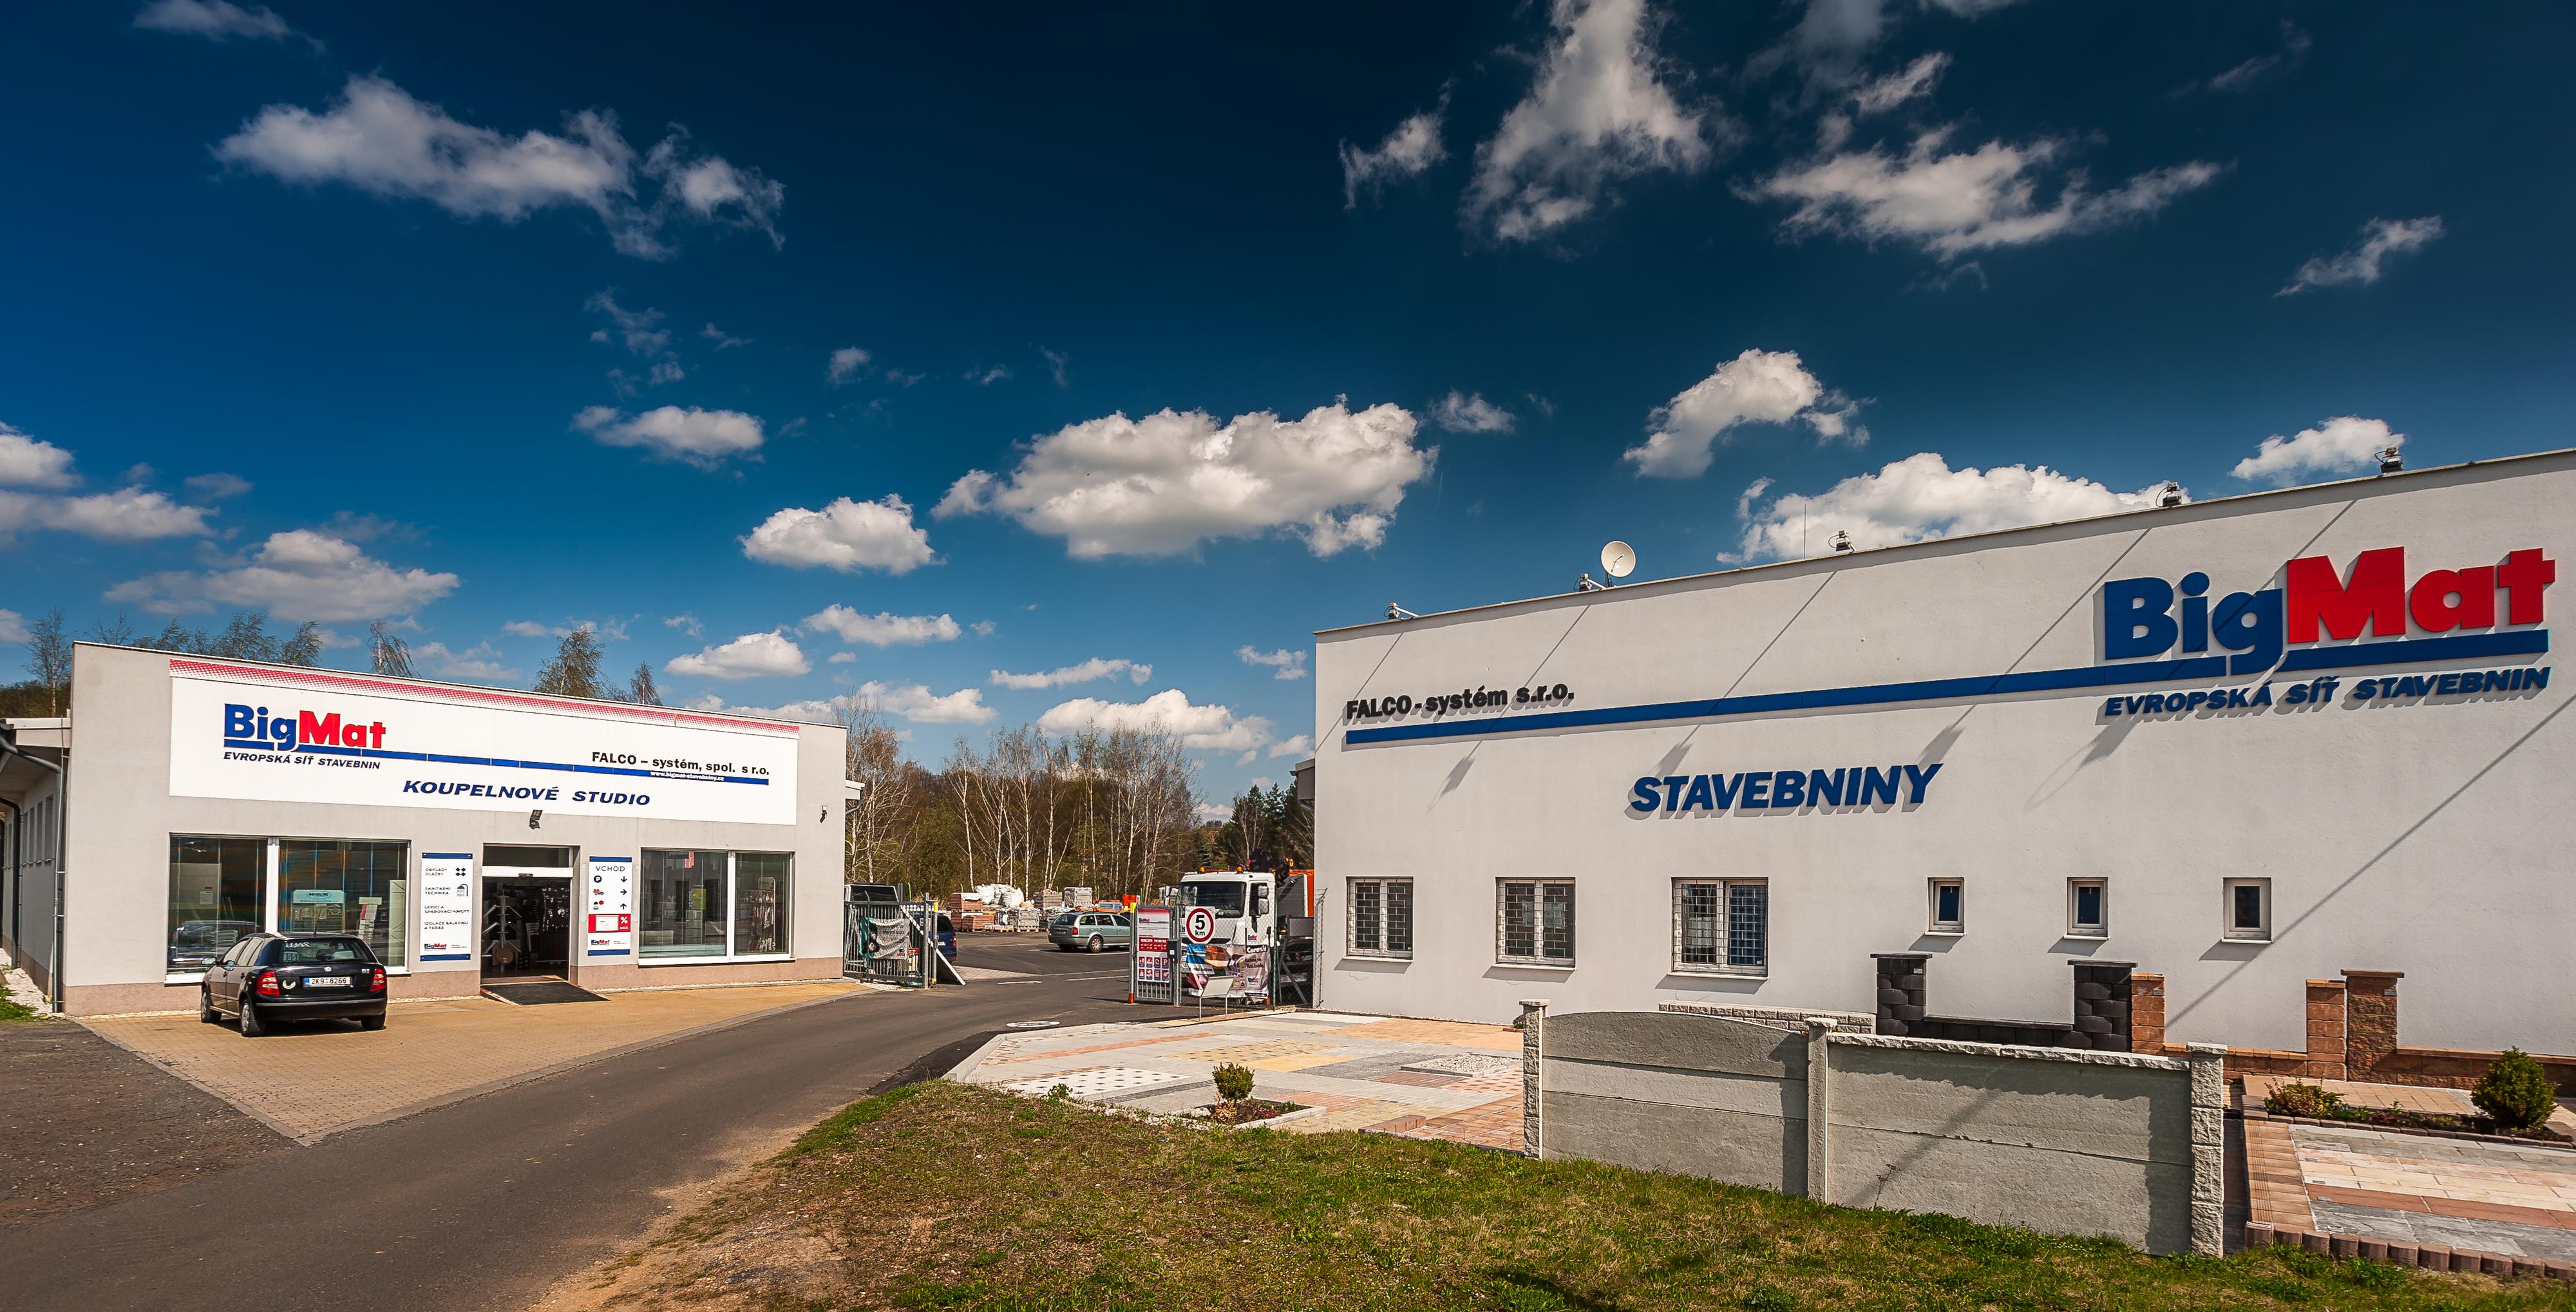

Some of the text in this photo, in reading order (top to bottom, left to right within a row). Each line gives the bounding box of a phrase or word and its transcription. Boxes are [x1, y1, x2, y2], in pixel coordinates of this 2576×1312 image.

[2104, 546, 2555, 676] BigMat
[1516, 683, 1575, 703] s.r.o.
[2104, 666, 2552, 717] EVROPSKÁ SÍŤ STAVEBNIN
[224, 703, 386, 751] BigMat
[223, 752, 381, 769] EVROPSKÁ SÍŤ STAVEBNIN
[592, 752, 637, 765] FALCO
[652, 757, 702, 772] systém,
[706, 763, 735, 774] spol.
[741, 765, 748, 774] s
[752, 766, 770, 775] r.o.
[402, 780, 650, 806] KOUPELNOVÉ STUDIO
[1630, 763, 1944, 812] STAVEBNINY
[1195, 915, 1206, 930] 5
